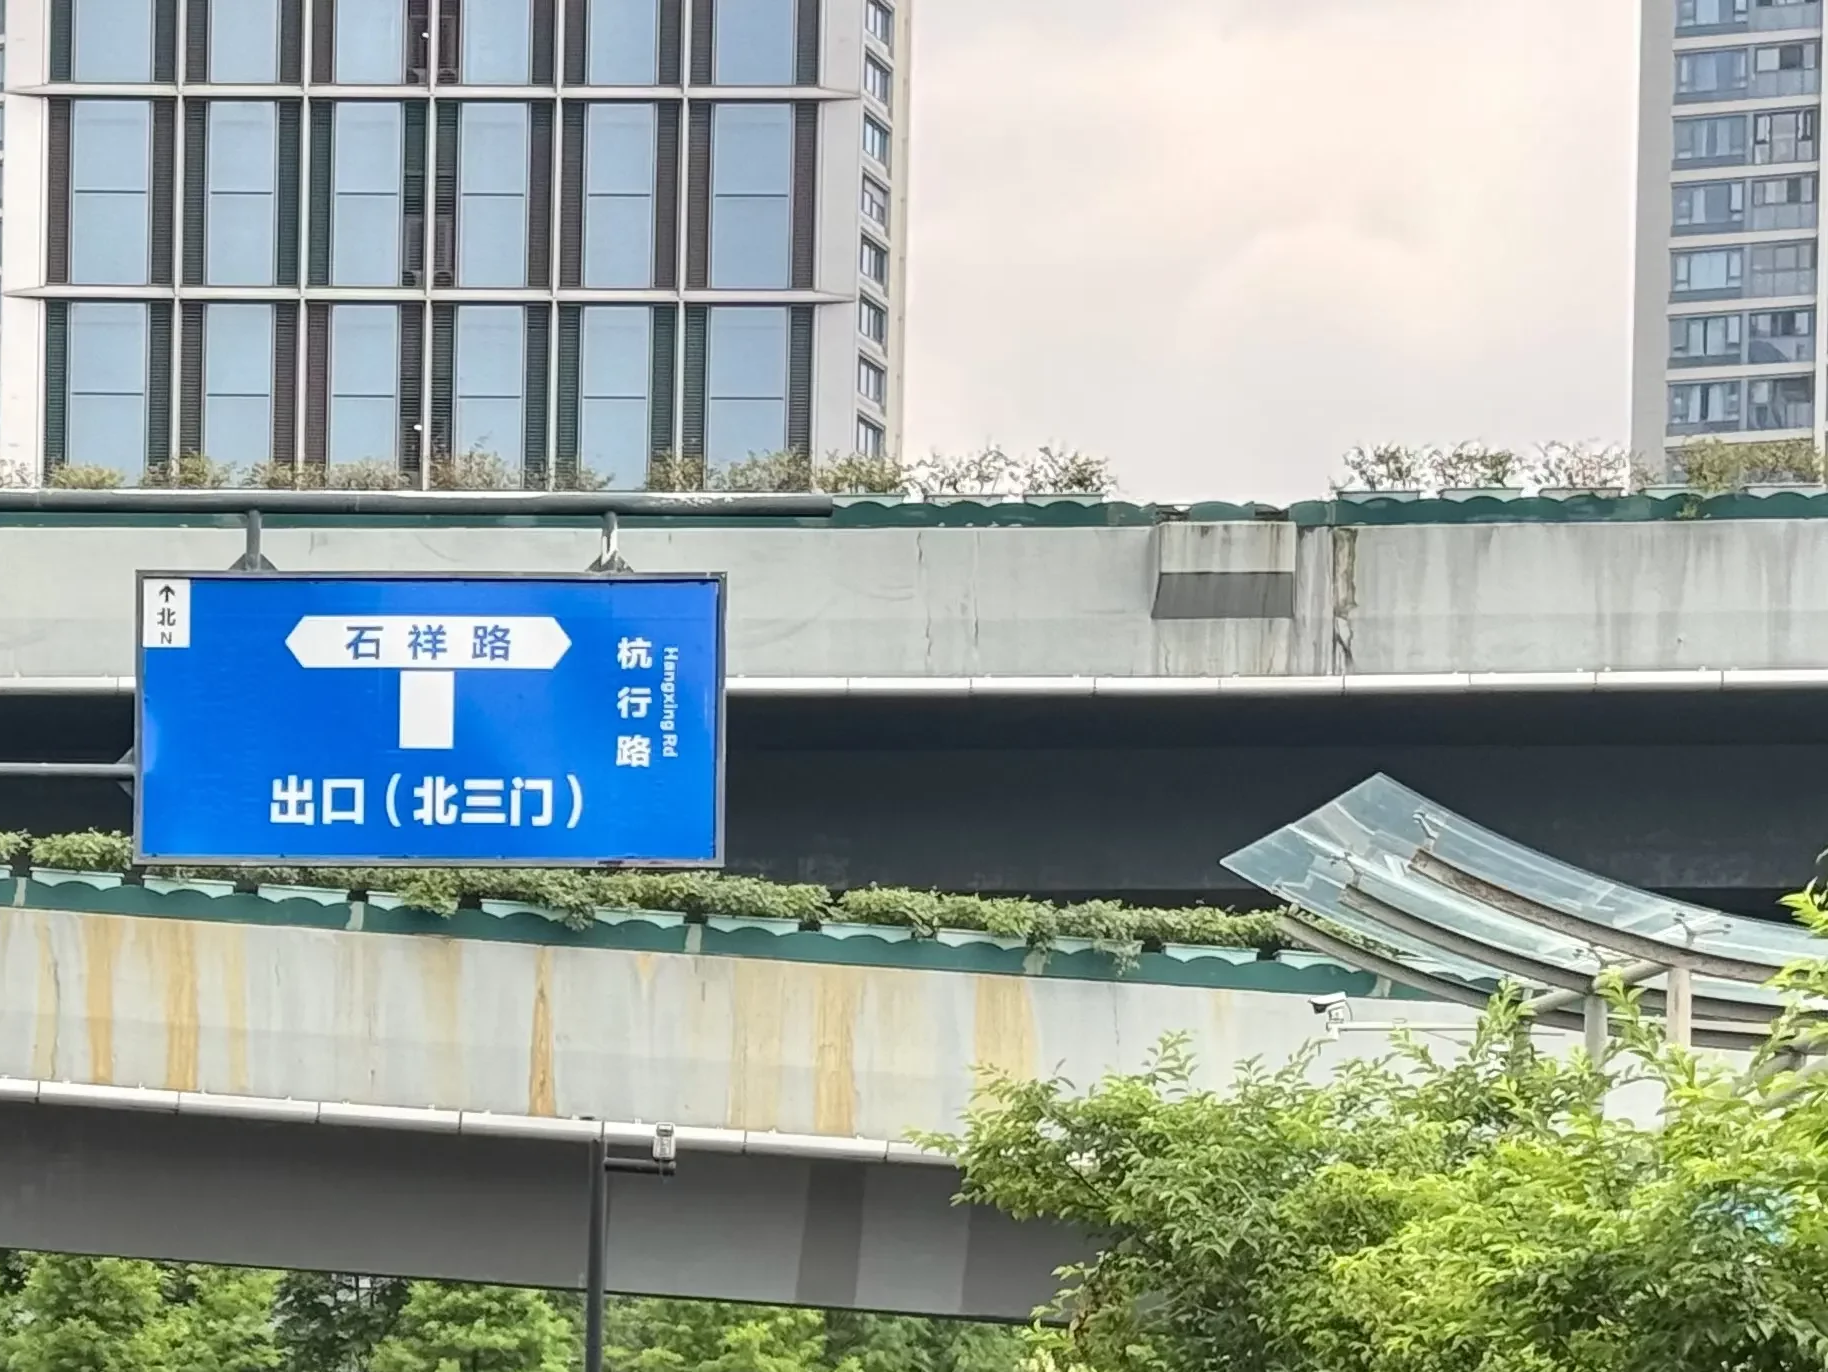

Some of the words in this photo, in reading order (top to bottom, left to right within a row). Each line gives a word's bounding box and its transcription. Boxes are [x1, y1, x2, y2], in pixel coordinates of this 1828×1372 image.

[156, 607, 177, 626] 北
[160, 631, 173, 645] N
[345, 624, 511, 661] 石祥路
[615, 636, 653, 768] 杭行路
[660, 646, 679, 731] Hangxing
[662, 734, 679, 758] Rd
[270, 773, 583, 829] 出口（北三门）
